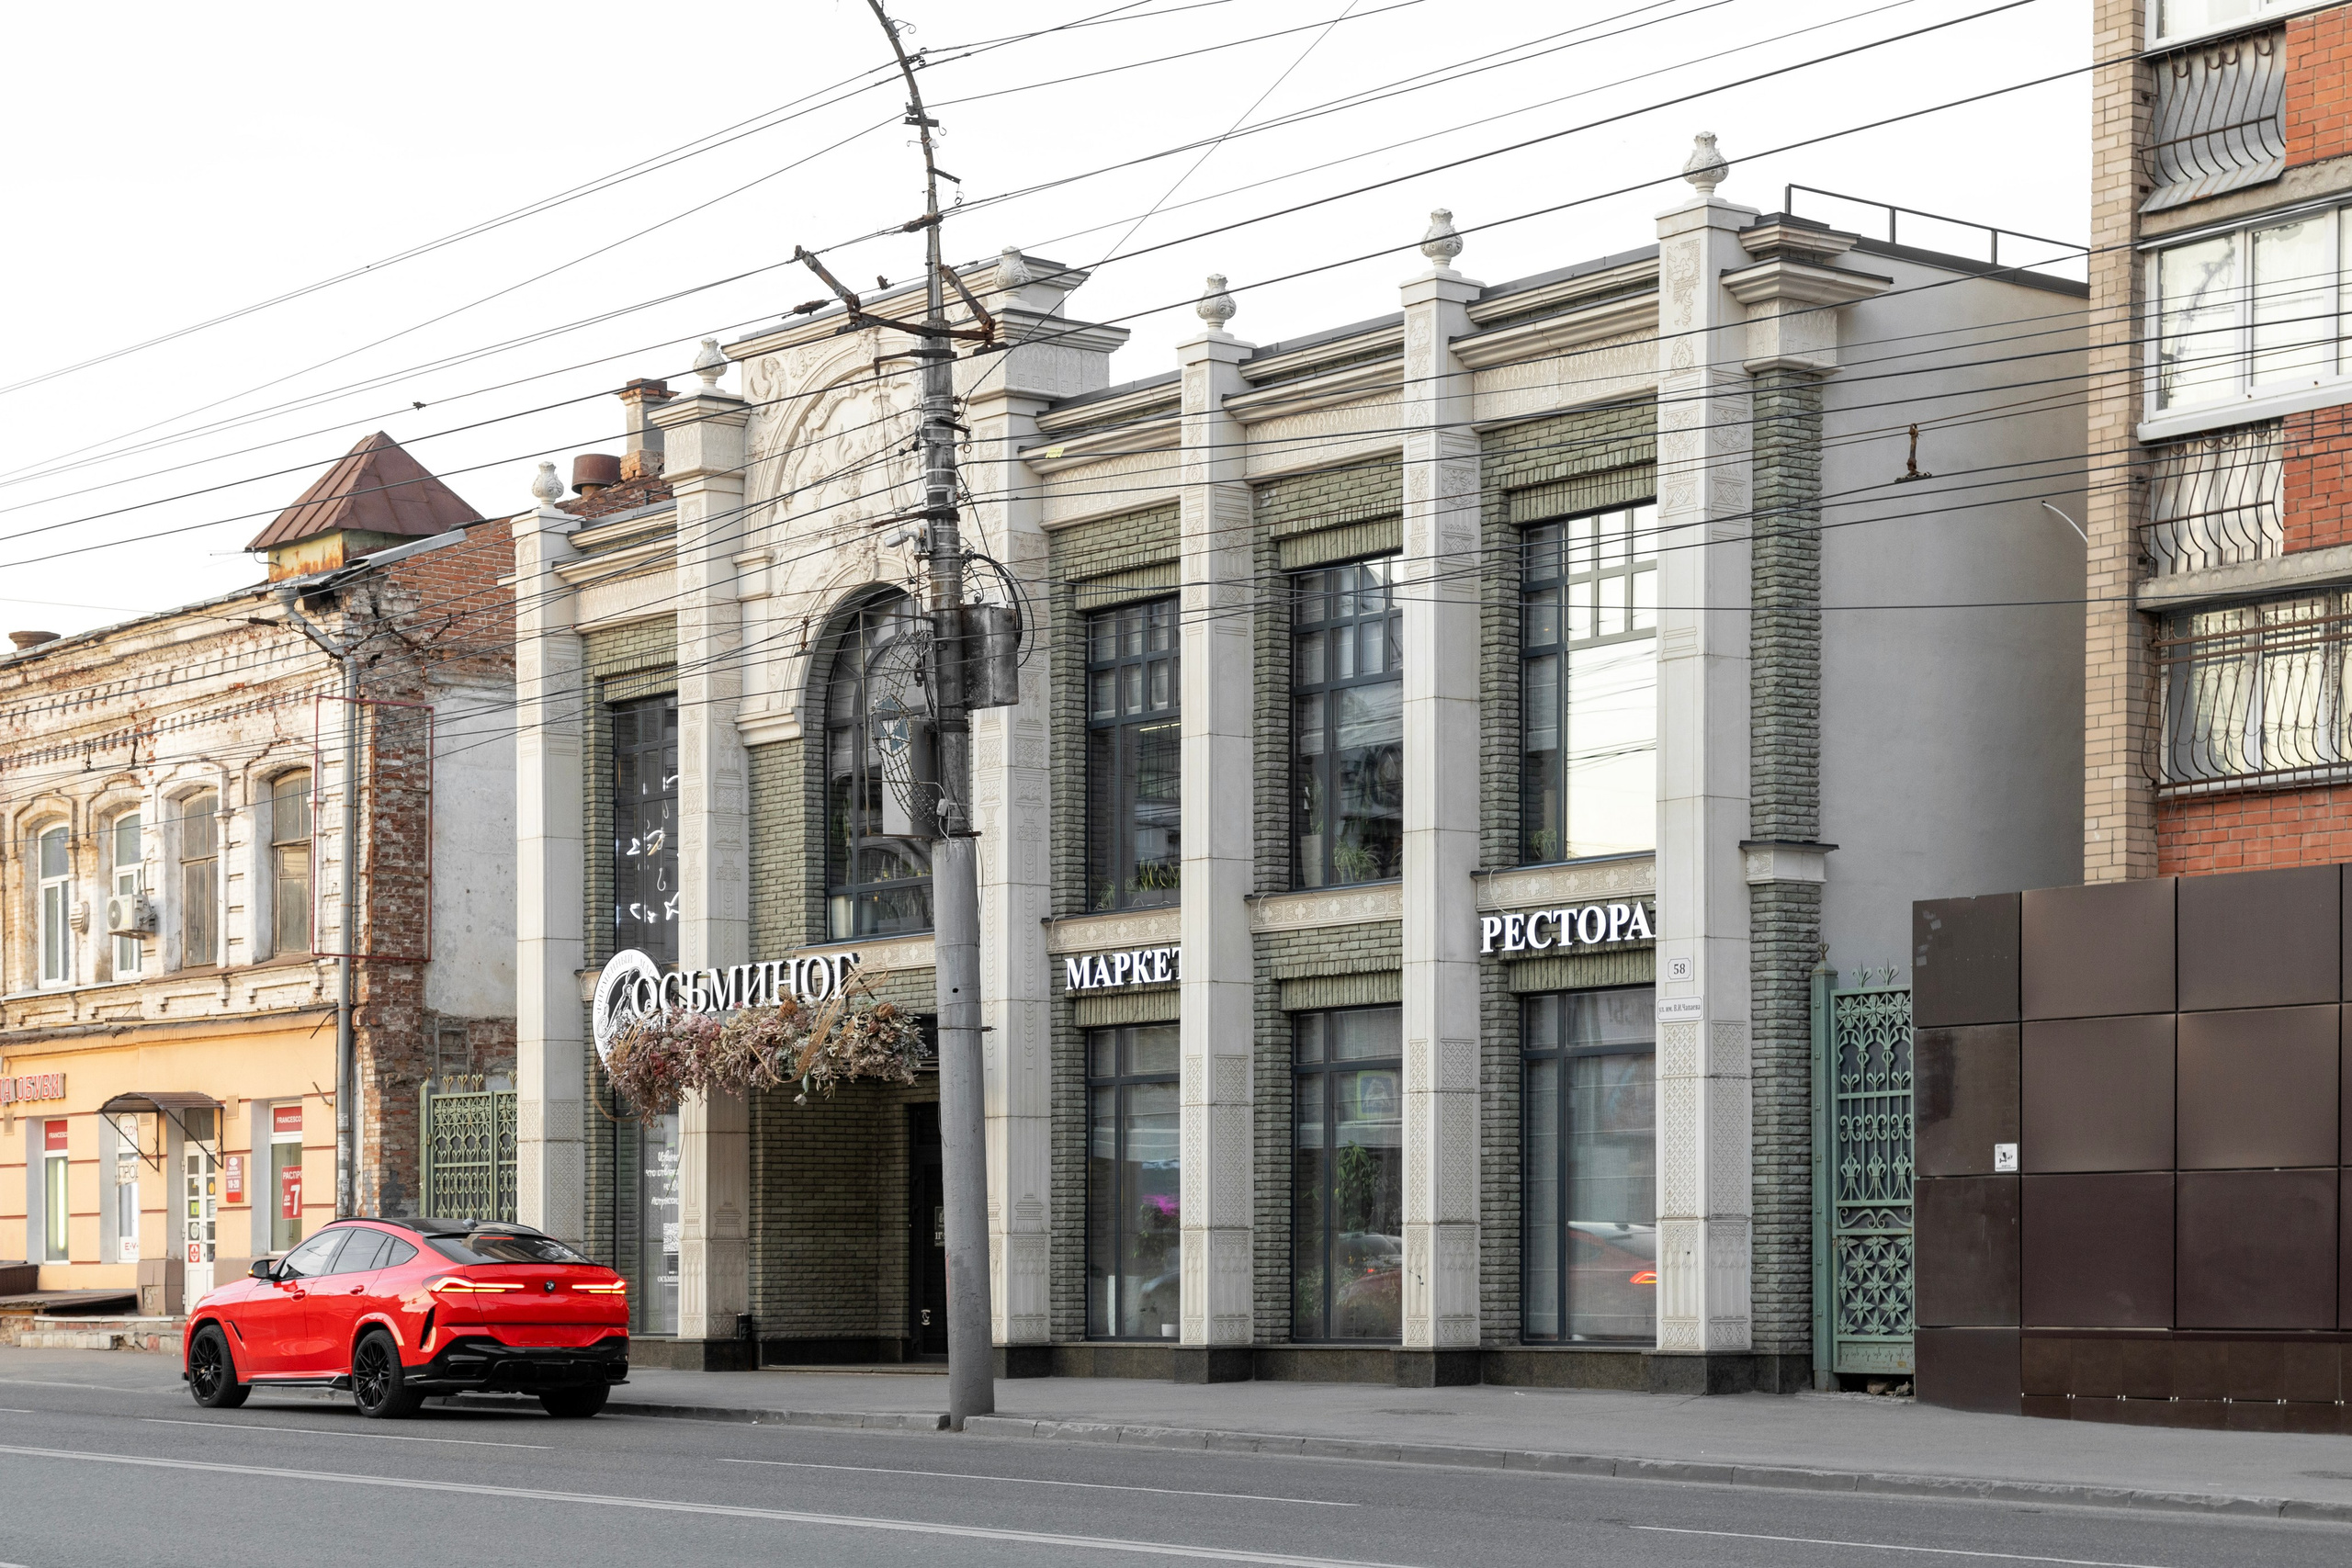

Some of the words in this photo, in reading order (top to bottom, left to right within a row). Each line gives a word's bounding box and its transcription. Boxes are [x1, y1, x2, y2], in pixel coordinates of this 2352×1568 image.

[1479, 901, 1657, 953] РЕСТОРА
[1673, 963, 1686, 975] 58
[631, 953, 857, 1021] ОСЬМИНОГ
[17, 1073, 61, 1101] ОБУВИ
[277, 1116, 302, 1124] FRANCESCO
